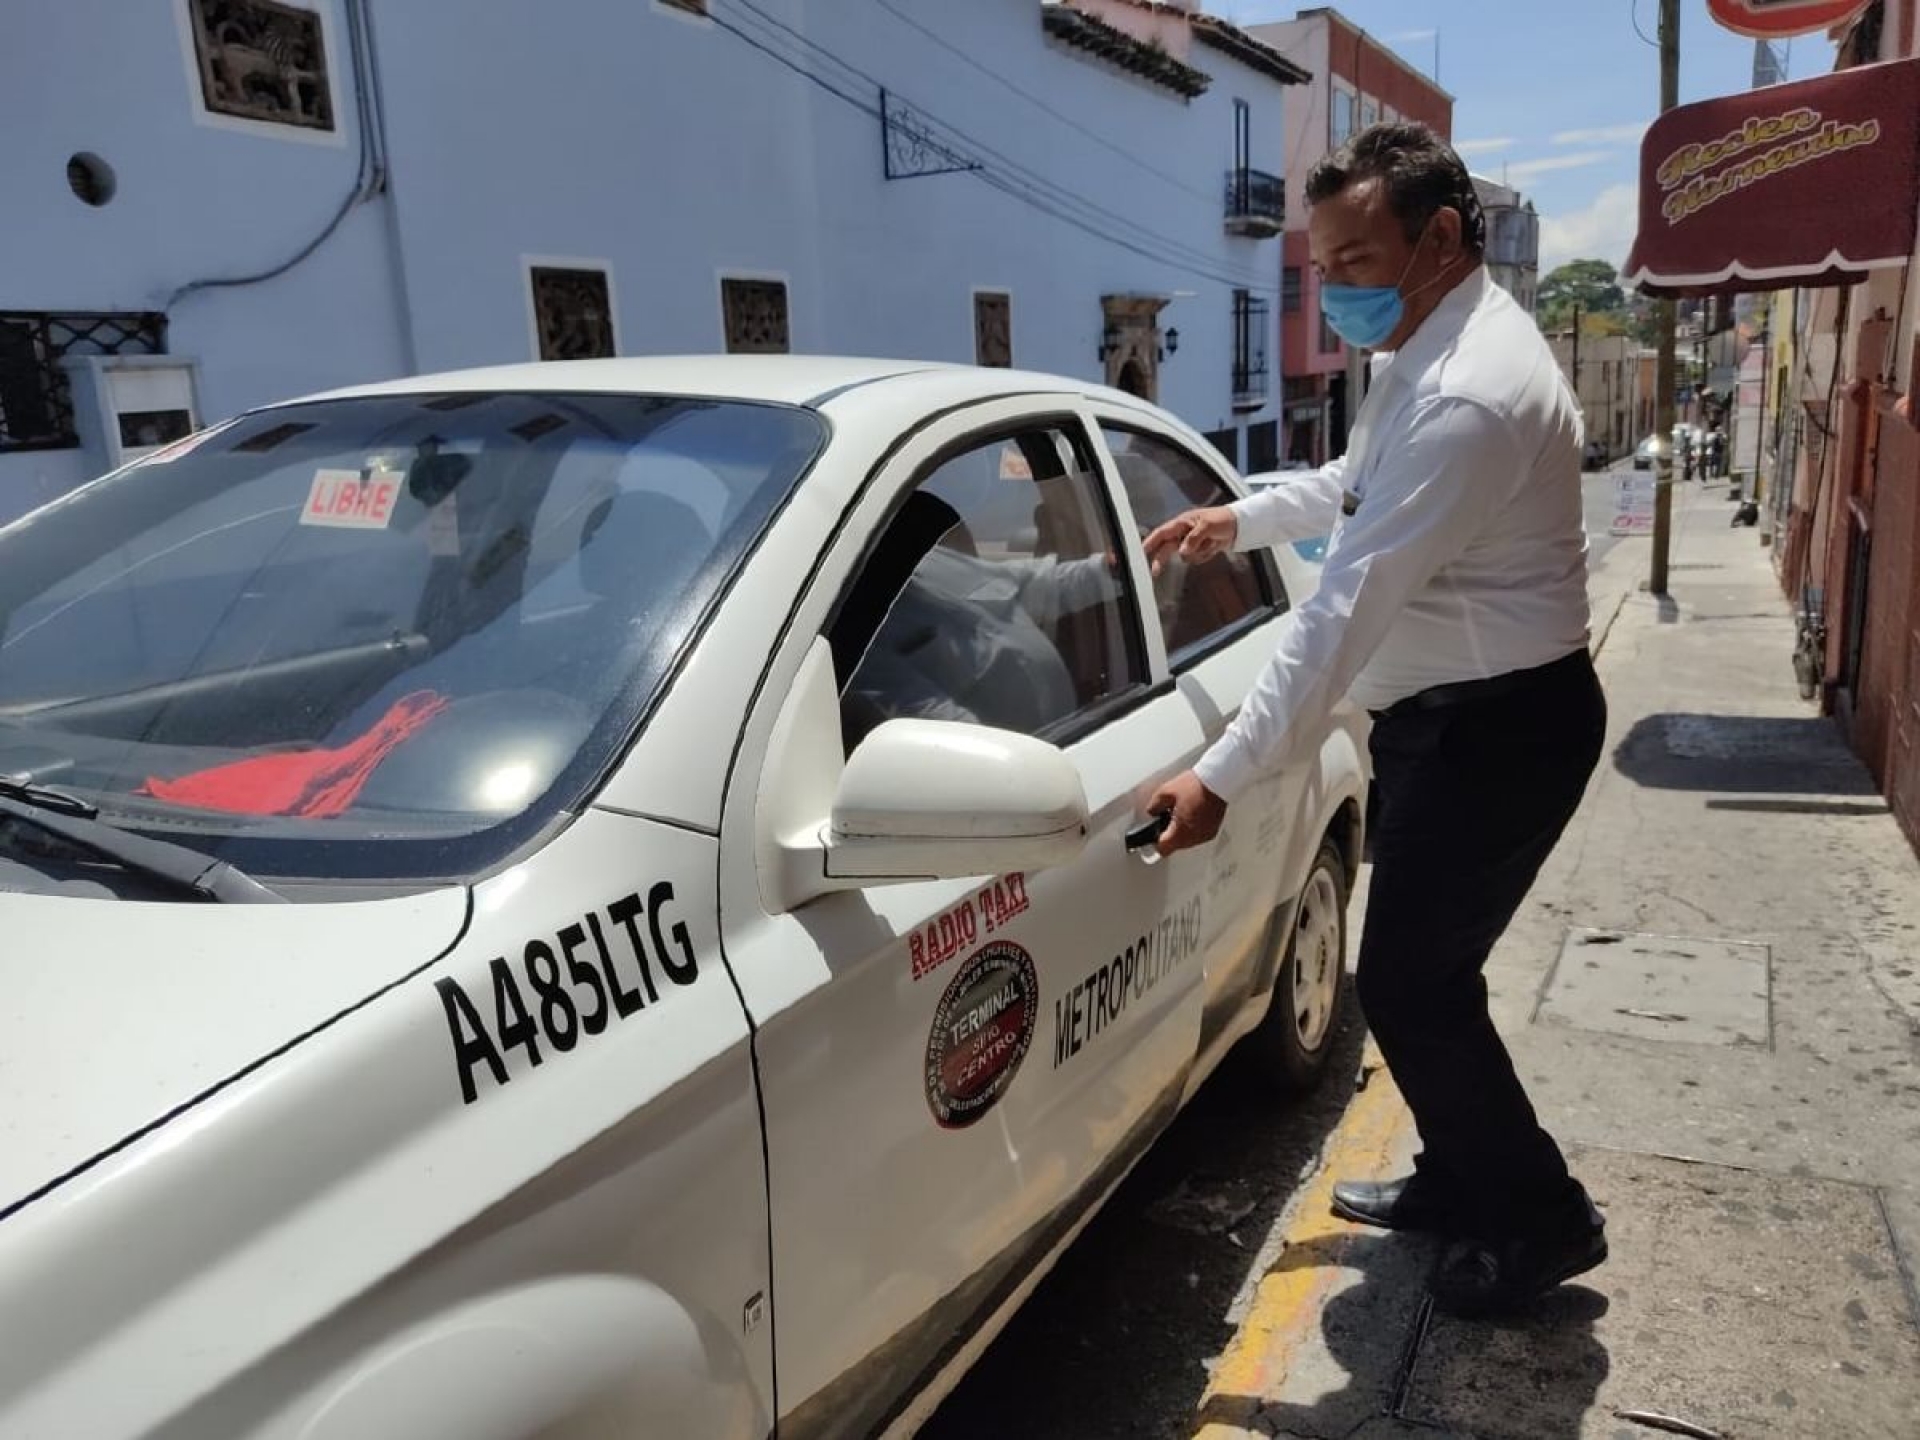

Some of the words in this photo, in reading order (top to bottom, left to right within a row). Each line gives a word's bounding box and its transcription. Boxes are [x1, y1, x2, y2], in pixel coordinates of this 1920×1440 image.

[908, 898, 978, 980] RADIO
[978, 871, 1030, 932] TAXI
[434, 881, 698, 1105] A485LTG
[950, 981, 1020, 1046] TERMINAL
[1053, 895, 1201, 1069] METROPOLITANO
[957, 1031, 1017, 1087] CENTRO
